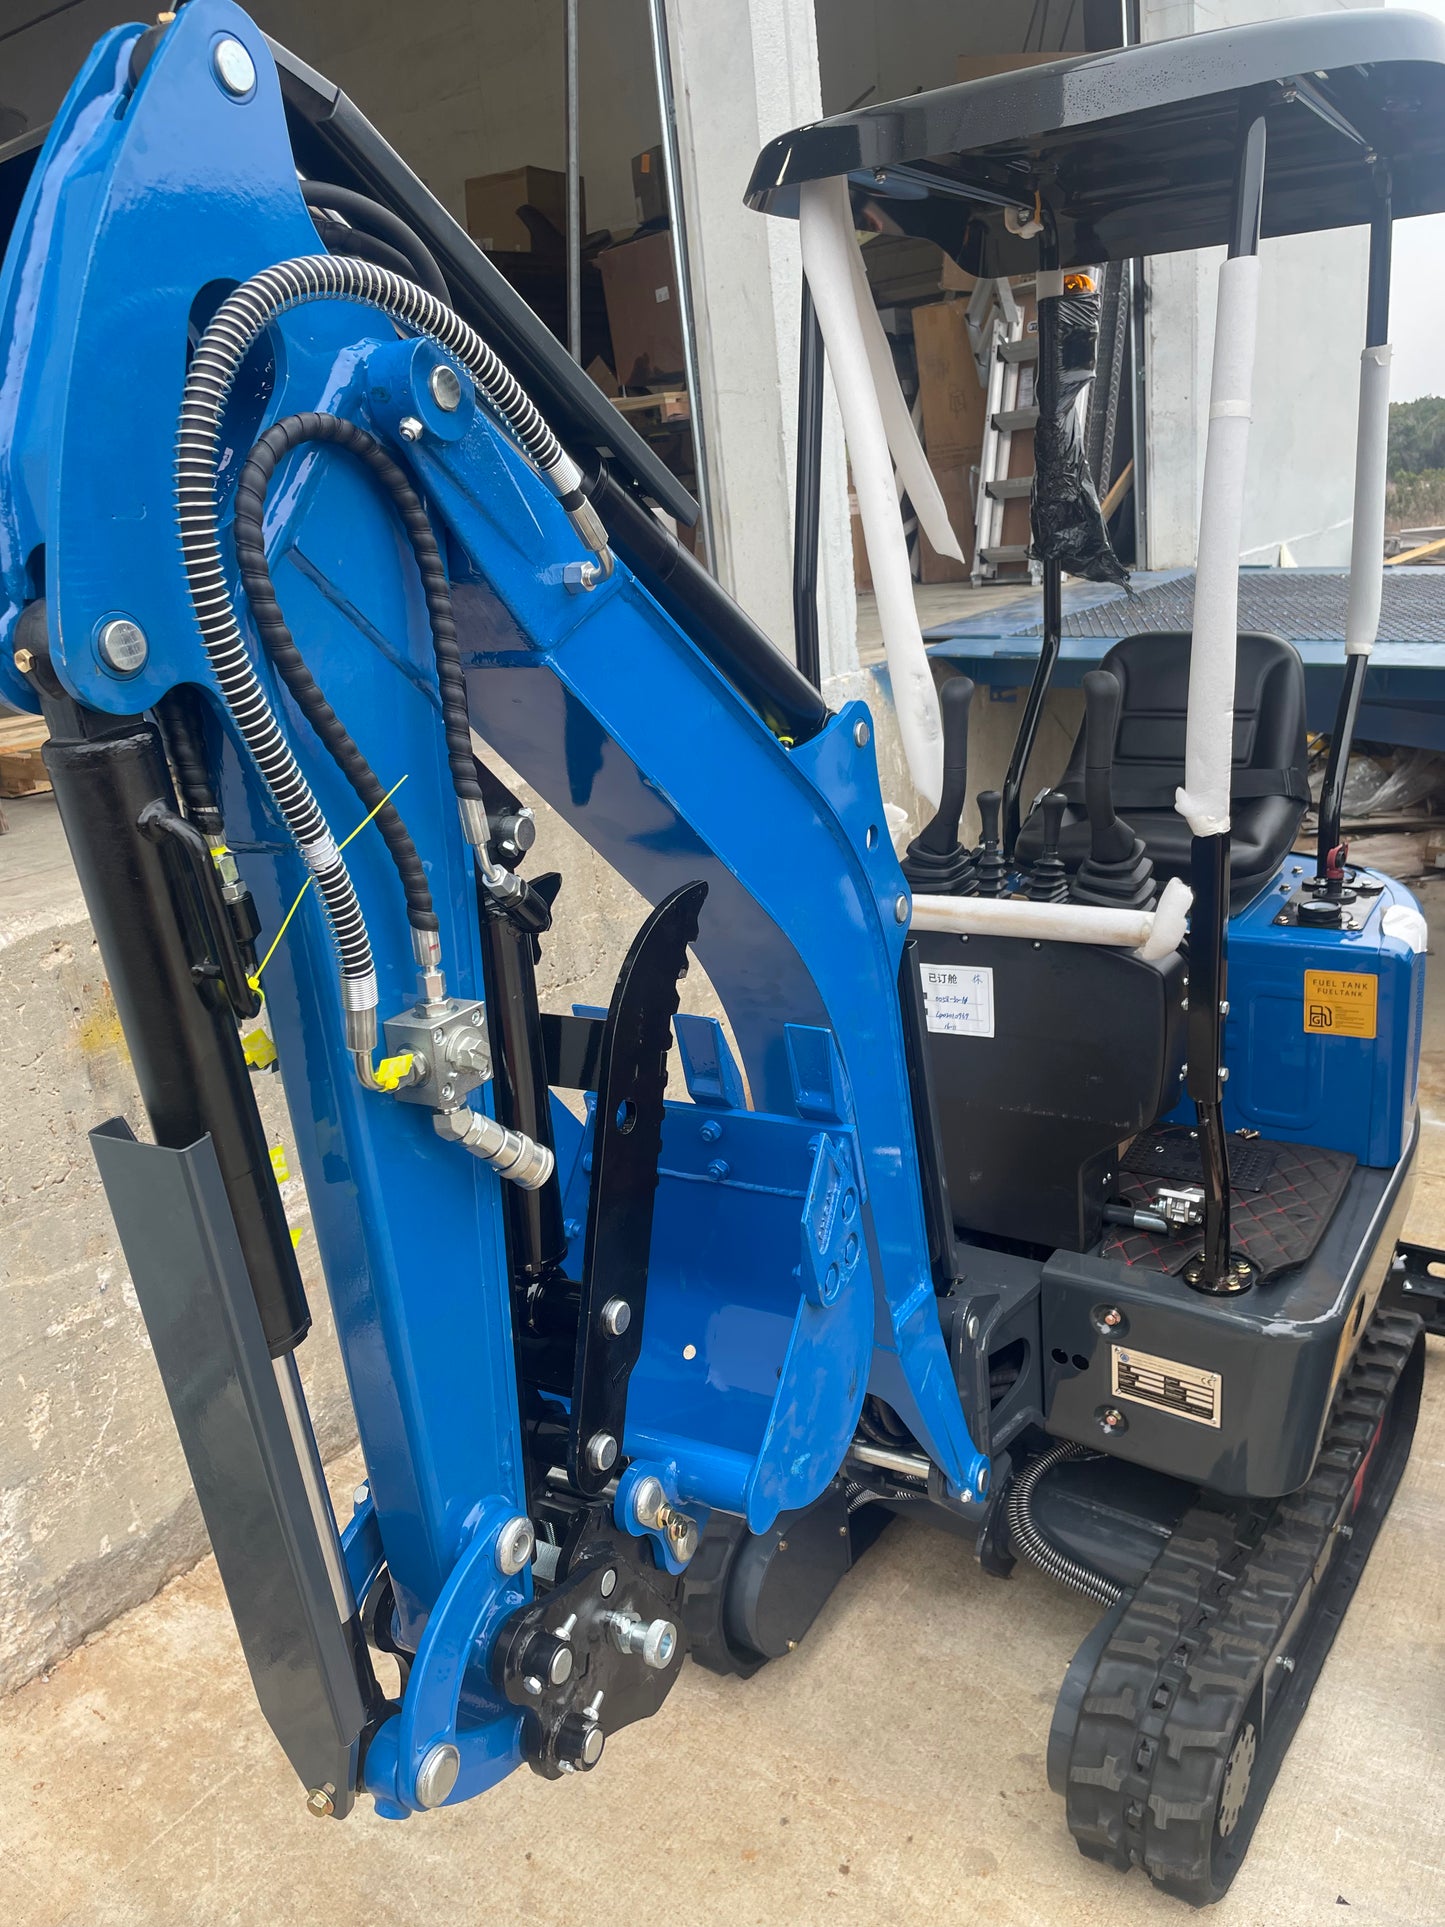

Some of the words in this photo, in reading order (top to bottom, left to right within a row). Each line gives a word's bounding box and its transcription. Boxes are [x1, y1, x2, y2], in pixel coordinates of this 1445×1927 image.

[1312, 978, 1337, 988] FUEL
[1341, 981, 1368, 990] TANK
[1316, 988, 1364, 998] FUELTANK
